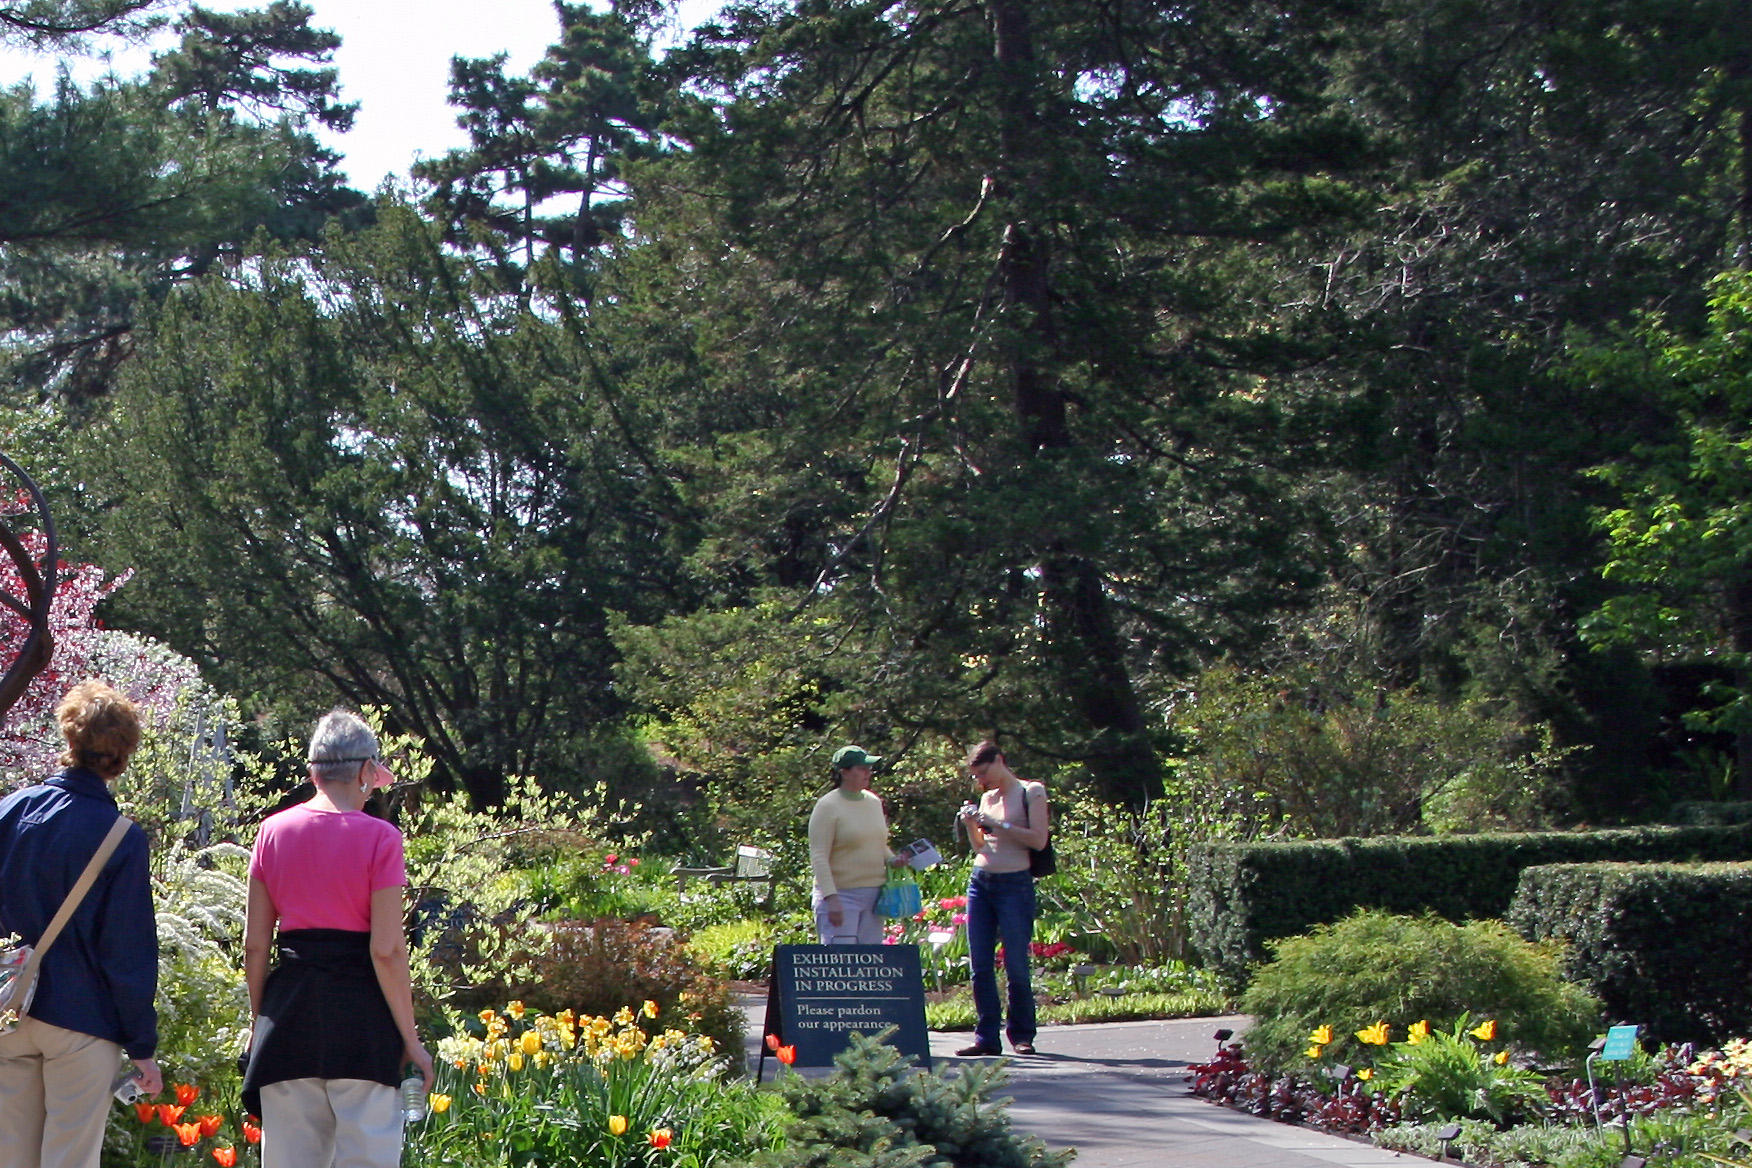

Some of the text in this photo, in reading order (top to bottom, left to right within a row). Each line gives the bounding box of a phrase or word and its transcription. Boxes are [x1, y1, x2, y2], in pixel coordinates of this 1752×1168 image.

[792, 953, 883, 965] EXHIBITION
[794, 966, 904, 978] INSTALLATION
[795, 980, 893, 992] IN PROGRESS
[797, 1004, 881, 1019] Please pardon
[798, 1020, 819, 1029] our
